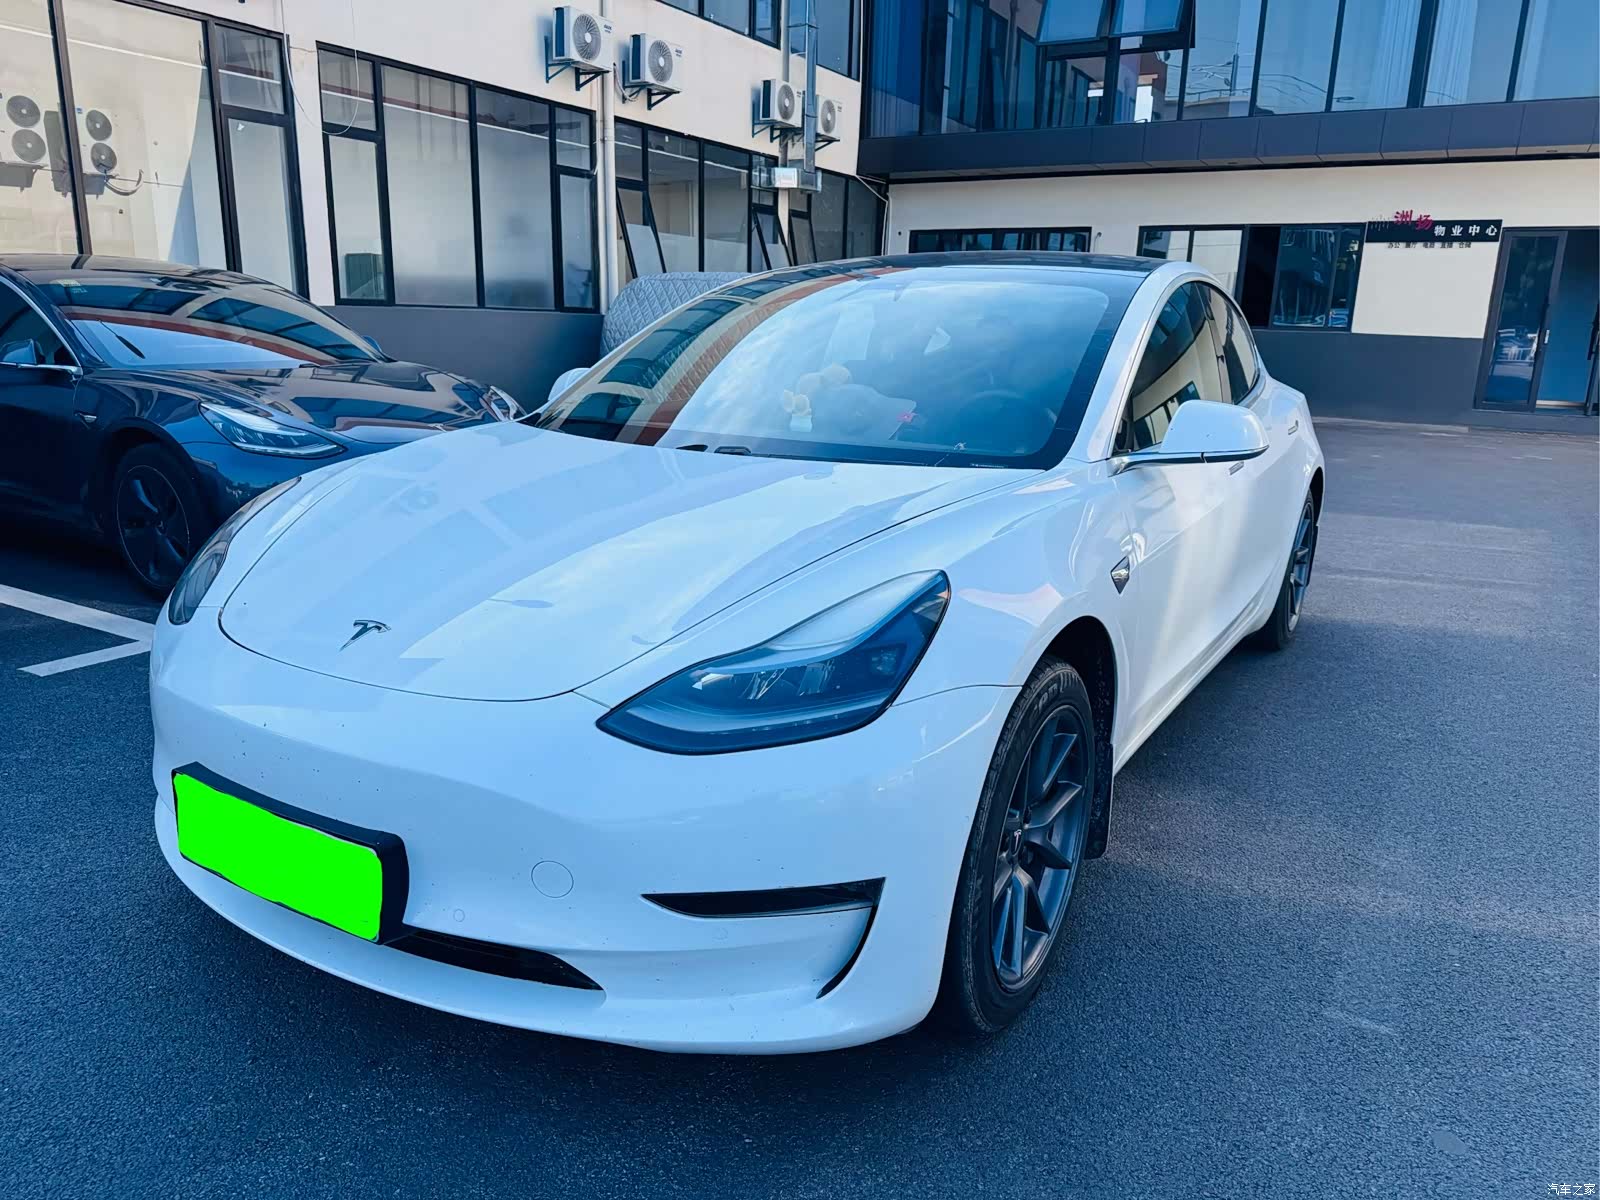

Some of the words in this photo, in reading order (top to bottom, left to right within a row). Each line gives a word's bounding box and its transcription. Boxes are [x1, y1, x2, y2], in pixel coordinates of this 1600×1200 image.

[1394, 209, 1433, 230] 洲扬
[1434, 225, 1498, 236] 物业中心
